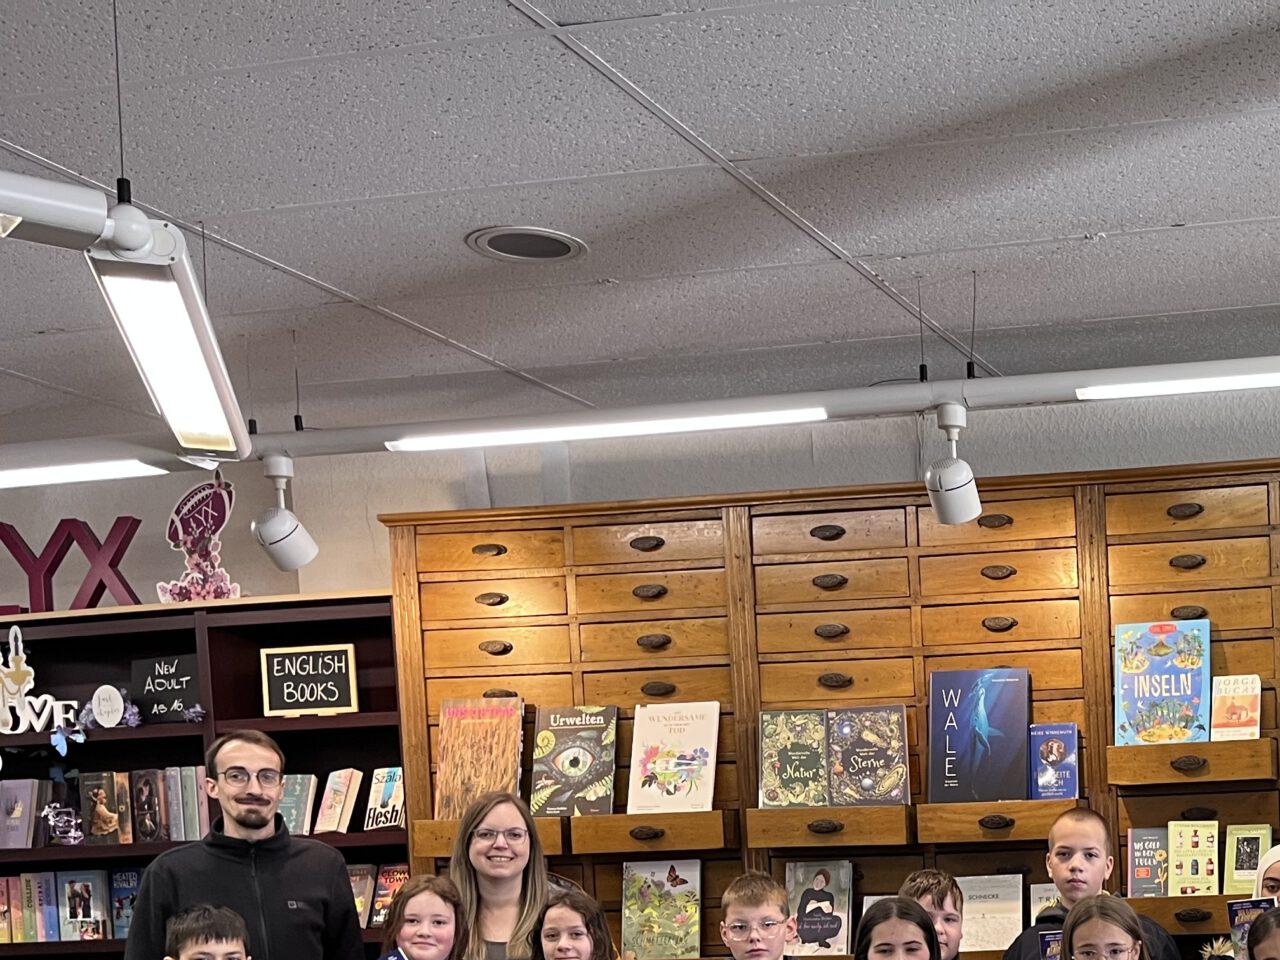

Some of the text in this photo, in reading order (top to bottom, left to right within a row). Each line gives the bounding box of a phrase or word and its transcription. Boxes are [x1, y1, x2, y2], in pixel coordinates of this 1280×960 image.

[0, 515, 142, 613] YX
[155, 659, 179, 676] NEW
[273, 653, 346, 676] ENGLISH
[144, 676, 191, 694] ADULT
[1134, 673, 1192, 698] INSELN
[1217, 678, 1257, 687] JORGE
[283, 681, 340, 703] BOOKS
[152, 703, 167, 714] AB
[550, 714, 604, 727] Urwelten
[941, 688, 962, 777] WALE
[782, 760, 817, 780] Natur
[849, 755, 885, 773] Sterne
[374, 773, 402, 785] Szala
[366, 805, 399, 829] Flesh
[381, 870, 410, 878] CLOW
